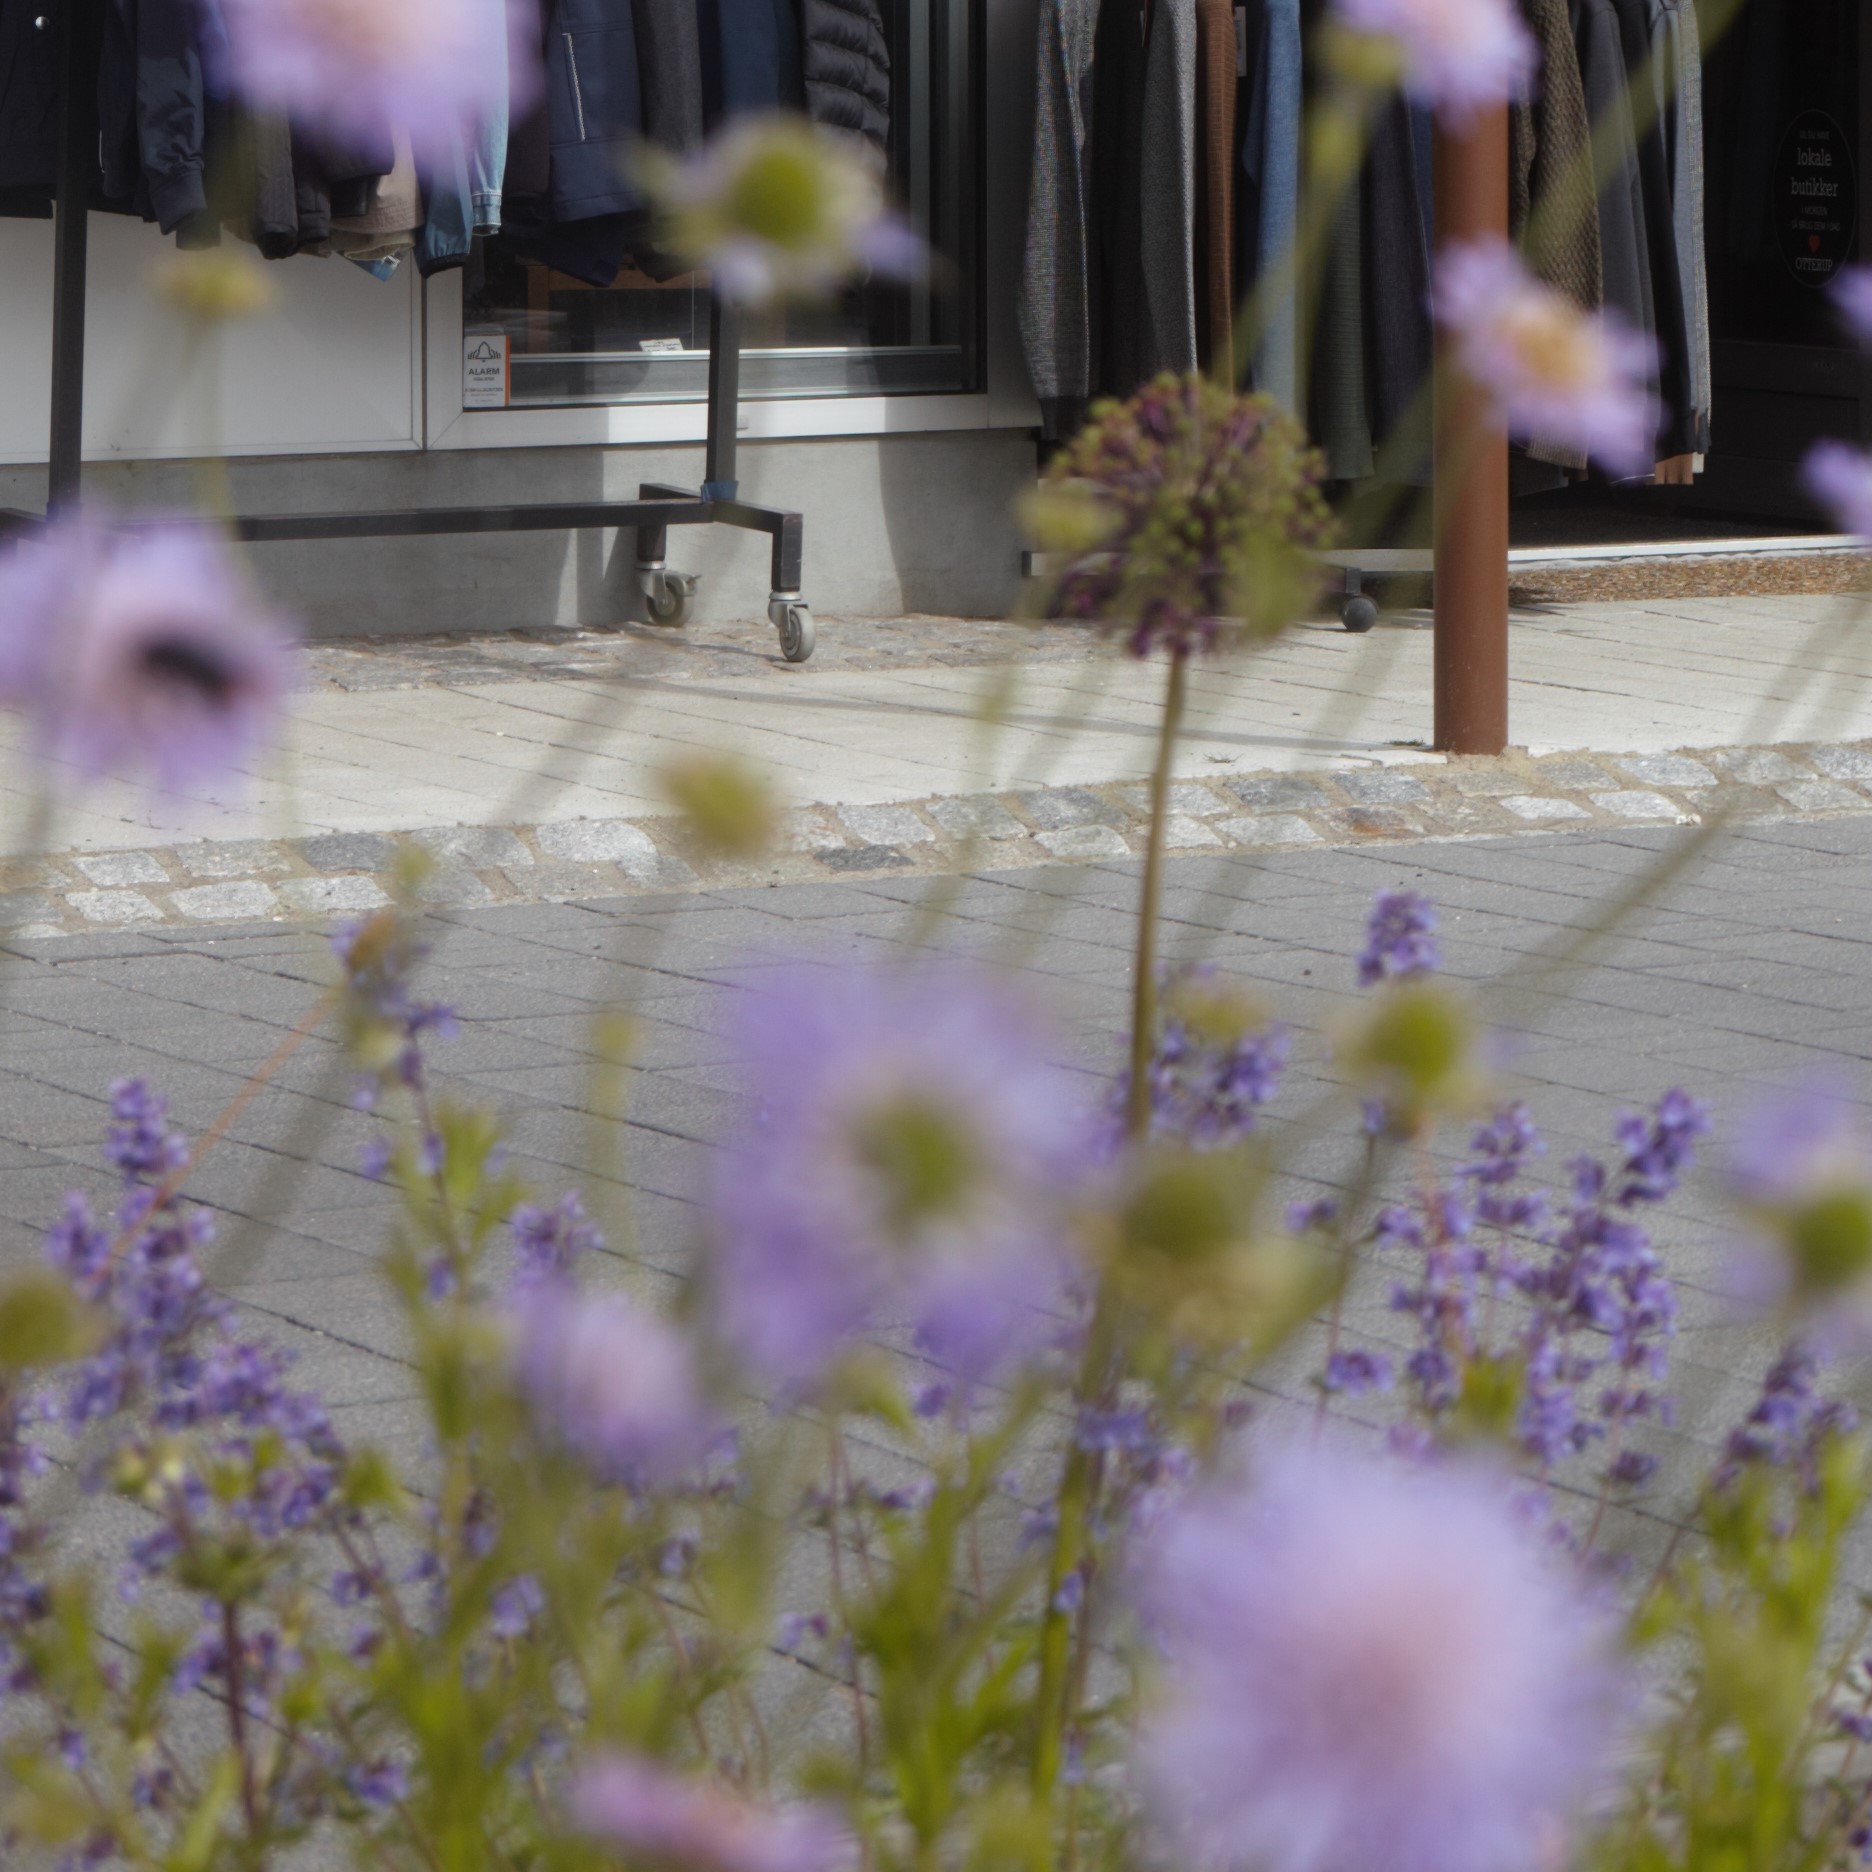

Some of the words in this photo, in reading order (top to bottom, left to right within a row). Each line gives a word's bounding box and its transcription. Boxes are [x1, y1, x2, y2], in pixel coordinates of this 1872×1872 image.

[1797, 147, 1832, 167] lokale
[1791, 177, 1838, 197] butikker
[1795, 257, 1833, 271] OTTERUP
[468, 367, 500, 375] ALARM
